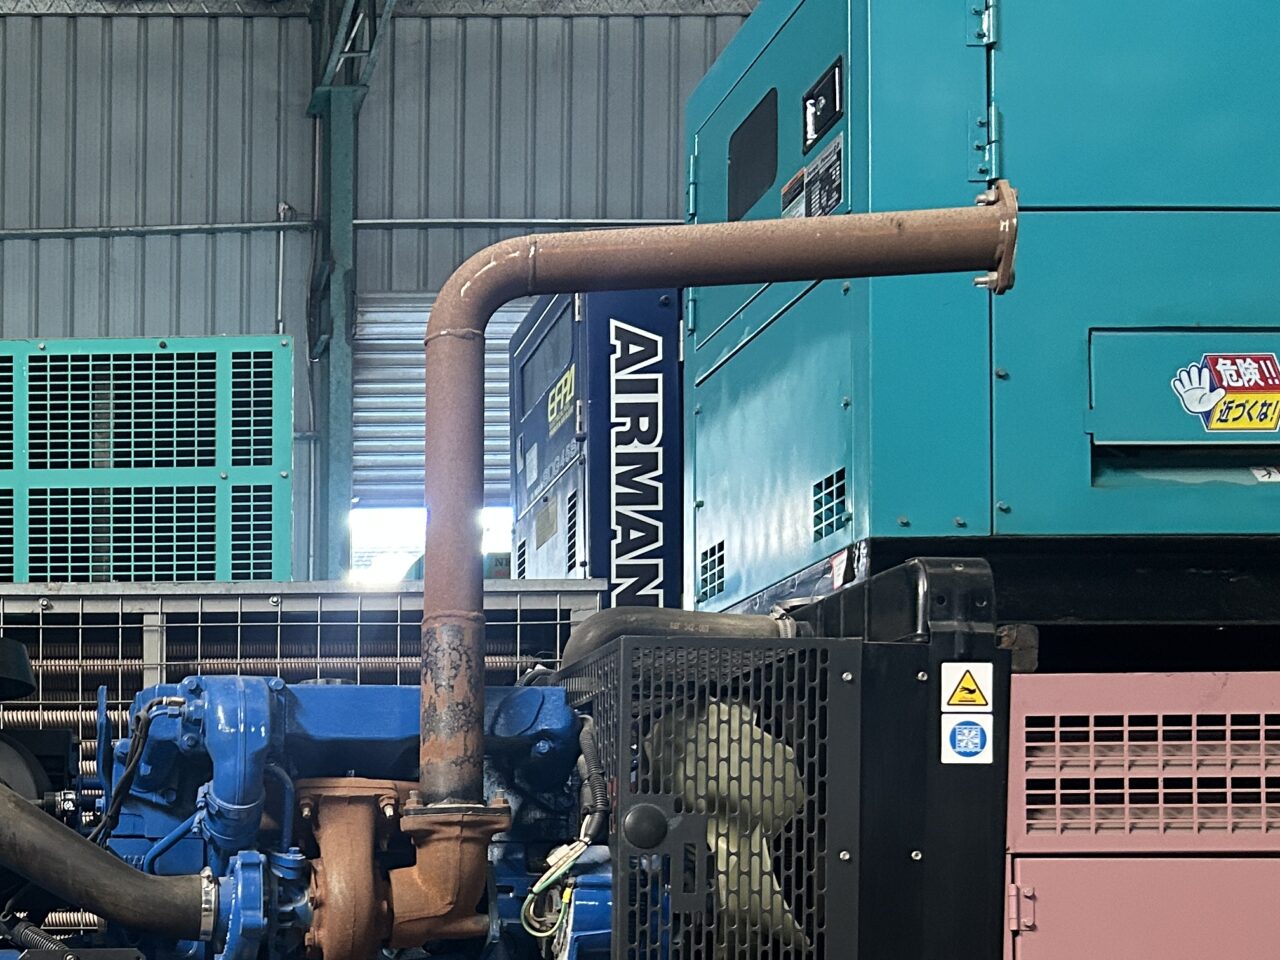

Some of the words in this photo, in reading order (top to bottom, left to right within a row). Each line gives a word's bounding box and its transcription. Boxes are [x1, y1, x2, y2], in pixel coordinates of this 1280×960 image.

[1215, 357, 1280, 388] 危険!!
[1216, 399, 1280, 423] 近づくな!
[610, 318, 664, 608] AIRMAN
